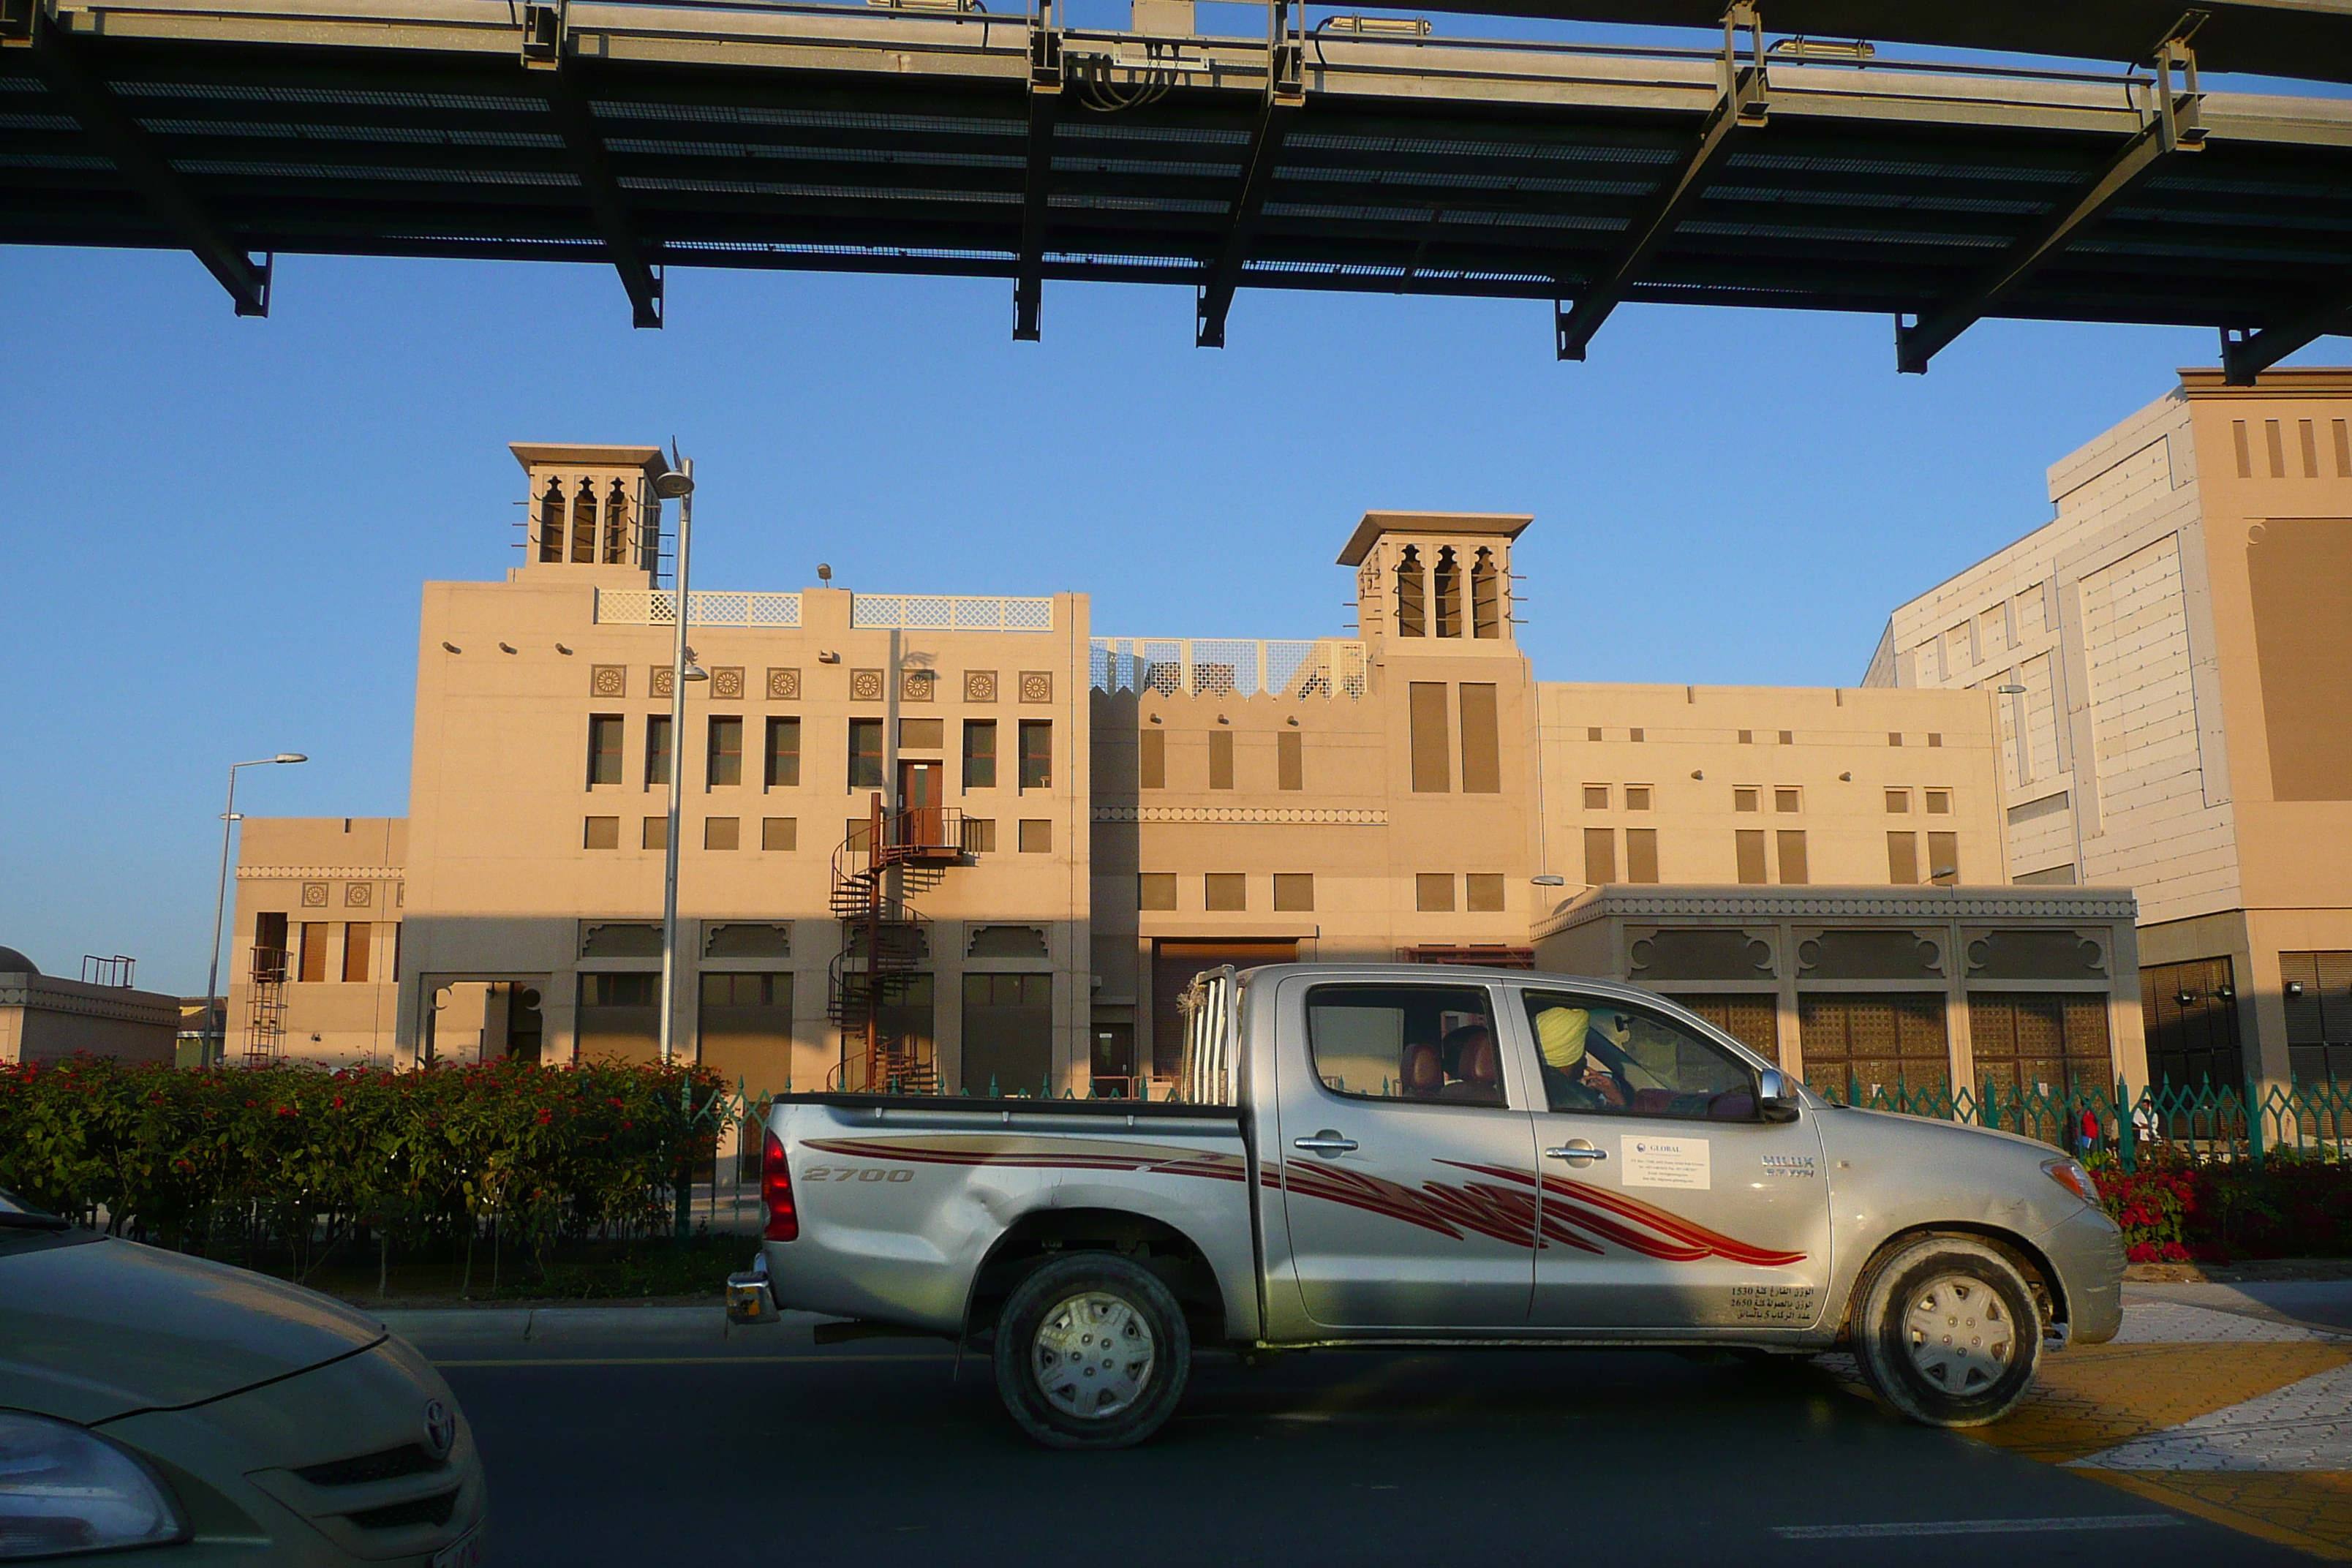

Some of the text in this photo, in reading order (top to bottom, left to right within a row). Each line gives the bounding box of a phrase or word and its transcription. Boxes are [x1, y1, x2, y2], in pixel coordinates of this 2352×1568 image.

[1650, 1145, 1681, 1153] GLOBAL
[1762, 1155, 1814, 1168] HILUX
[801, 1167, 915, 1183] 2700
[1732, 1287, 1753, 1295] 1530
[1770, 1286, 1792, 1297] الفارغ
[1794, 1287, 1814, 1297] الوزن
[1731, 1299, 1752, 1307] 2650
[1795, 1300, 1813, 1310] الوزن
